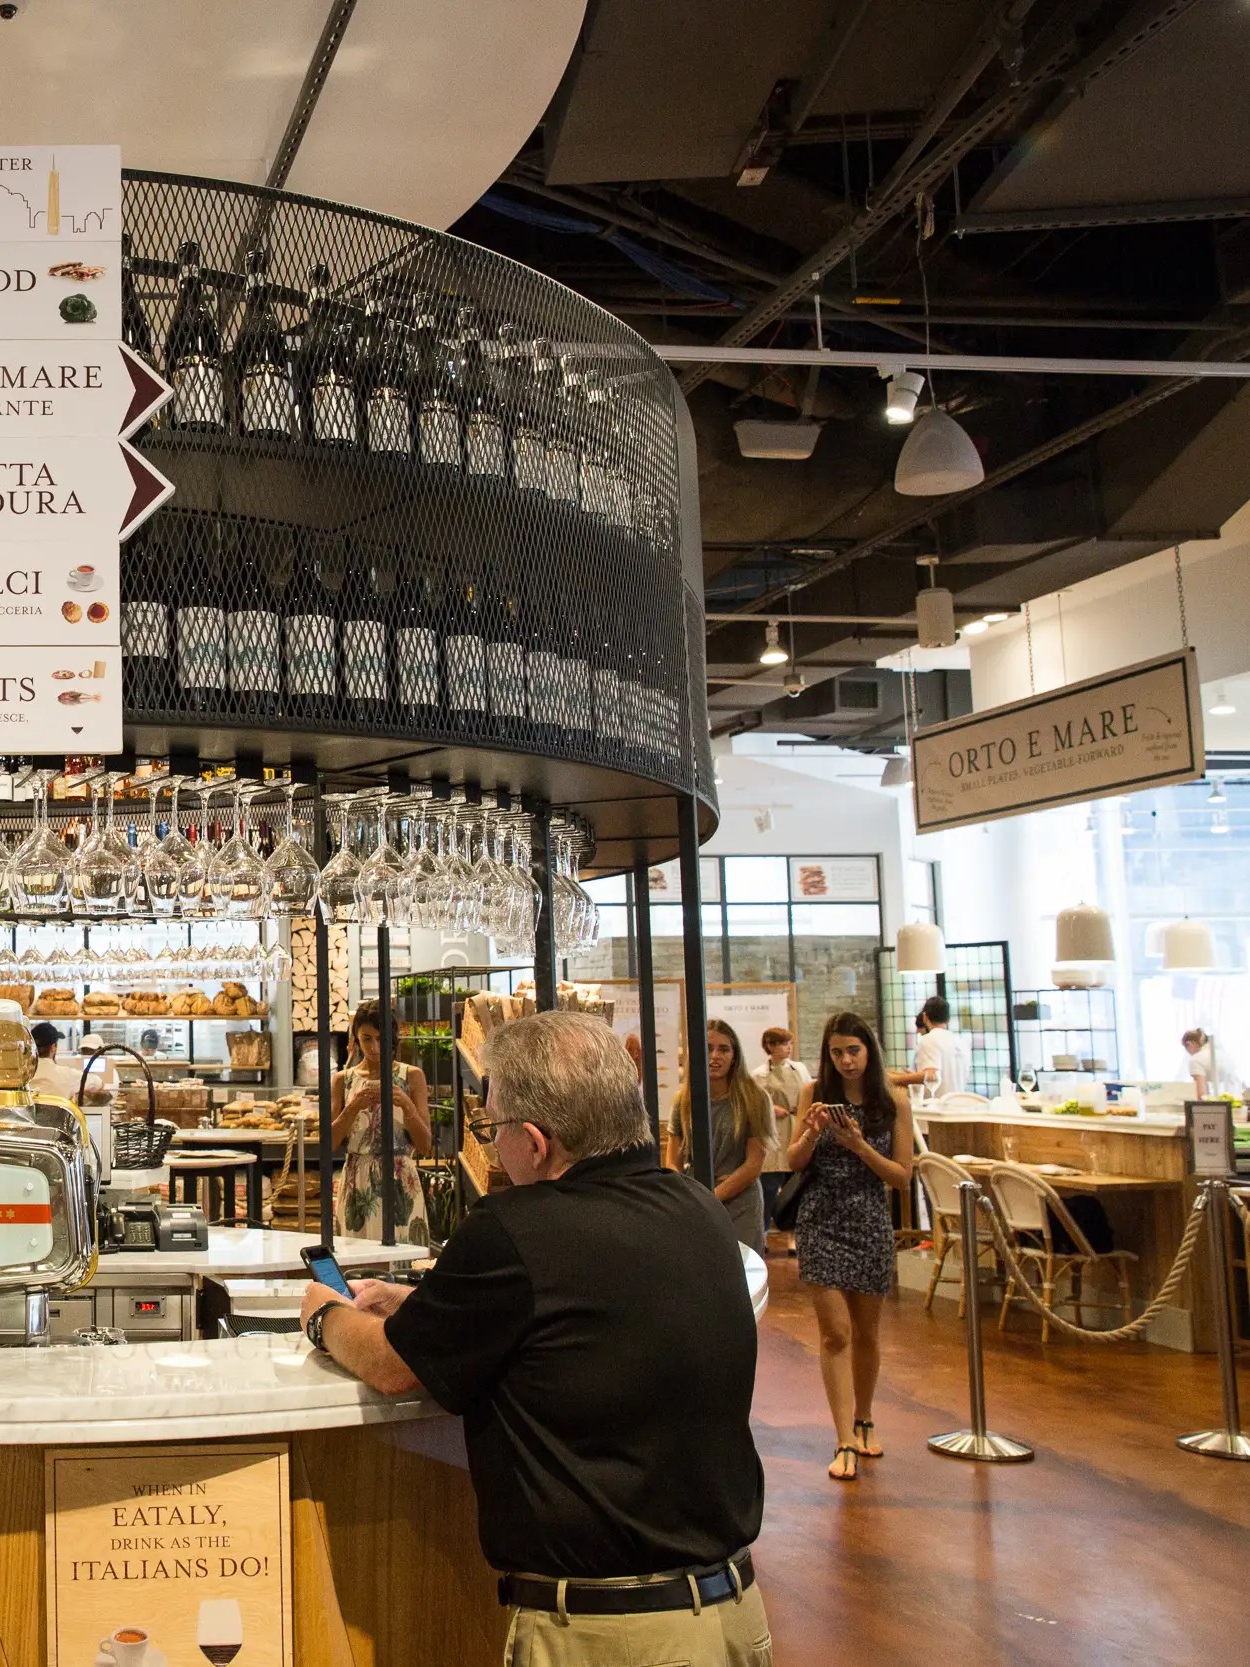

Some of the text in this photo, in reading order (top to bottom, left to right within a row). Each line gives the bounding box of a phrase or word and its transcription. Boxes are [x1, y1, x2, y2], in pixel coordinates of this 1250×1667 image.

[949, 703, 1140, 778] ORTO E MARE
[132, 1483, 207, 1497] WHEN IN
[111, 1504, 227, 1527] EATALY,
[111, 1535, 231, 1551] DRINK AS THE
[71, 1556, 269, 1581] ITALIANS DO!
